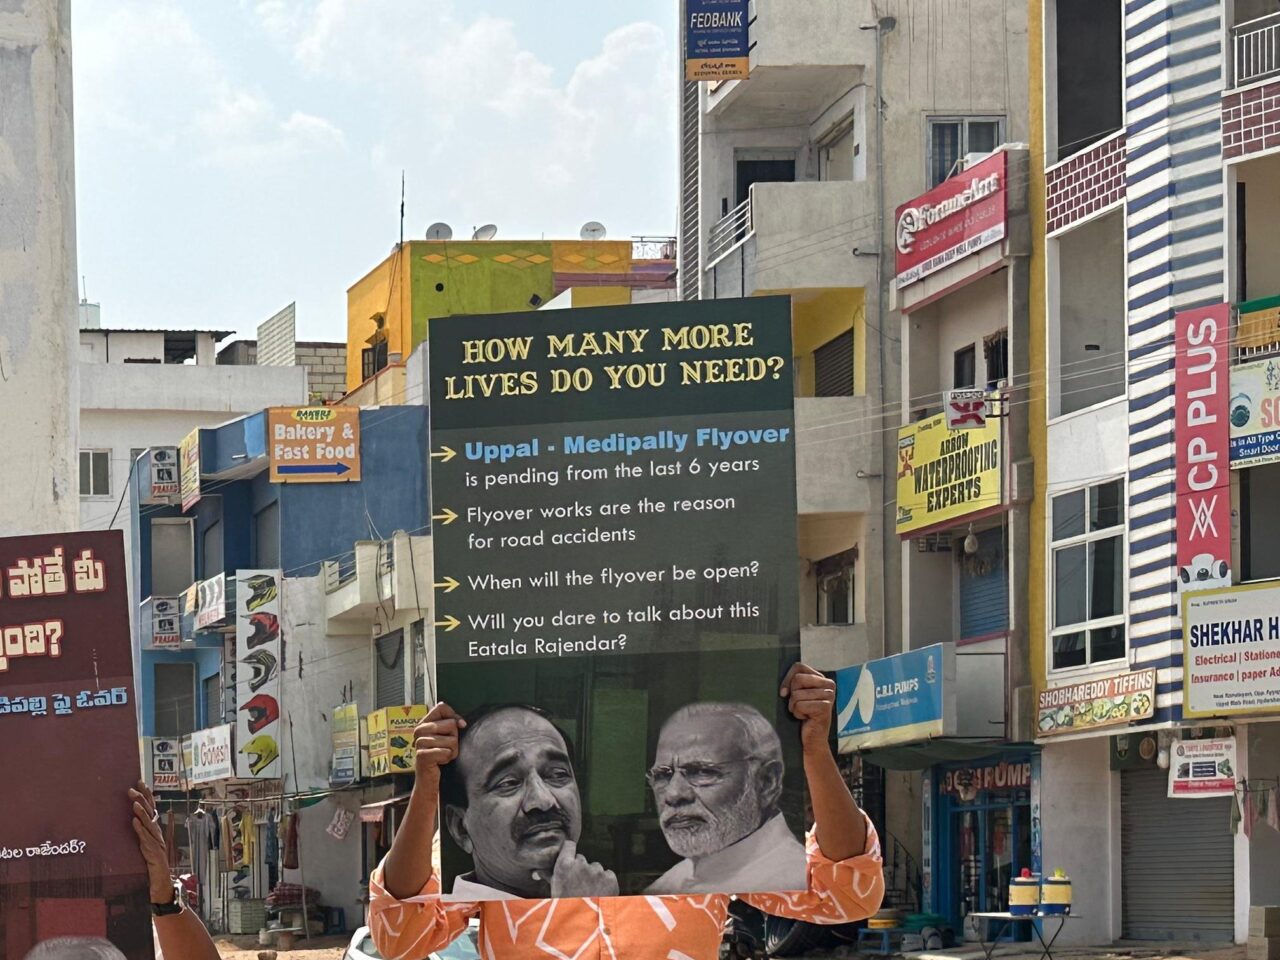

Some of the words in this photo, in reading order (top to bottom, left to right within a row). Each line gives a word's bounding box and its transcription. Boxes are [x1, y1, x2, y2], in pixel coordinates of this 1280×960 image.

[462, 336, 533, 363] HOW
[547, 329, 649, 357] MANY
[661, 323, 754, 350] MORE
[445, 371, 538, 399] LIVES
[551, 368, 592, 392] DO
[604, 363, 666, 389] YOU
[680, 356, 784, 385] NEED?
[1186, 317, 1218, 427] PLUS
[275, 424, 335, 442] Bakery
[342, 423, 354, 439] &
[466, 439, 538, 463] Uppal
[565, 431, 688, 455] Medipally
[697, 428, 789, 450] Flyover
[274, 444, 310, 460] Fast
[316, 443, 356, 460] Food
[914, 439, 997, 495] WATERPROOFING
[1187, 436, 1218, 491] CP
[466, 472, 477, 487] is
[485, 468, 558, 489] pending
[567, 465, 608, 481] from
[615, 463, 643, 478] the
[651, 461, 681, 476] last
[689, 458, 700, 474] 6
[708, 460, 759, 478] years
[926, 476, 981, 513] EXPERTS
[468, 507, 533, 526] Flyover
[540, 501, 592, 517] works
[600, 504, 631, 516] are
[638, 498, 665, 513] the
[674, 498, 735, 512] reason
[469, 533, 493, 549] for
[501, 530, 544, 547] road
[552, 527, 636, 545] accidents
[8, 547, 66, 597] పోతే
[73, 550, 105, 591] మీ
[468, 574, 521, 590] When
[529, 571, 558, 587] will
[566, 570, 593, 585] the
[601, 568, 665, 587] flyover
[673, 565, 697, 580] be
[704, 561, 759, 582] open?
[468, 613, 504, 629] Will
[513, 616, 544, 633] you
[552, 610, 596, 627] dare
[603, 610, 620, 623] to
[627, 606, 661, 622] talk
[670, 604, 723, 620] about
[730, 602, 759, 618] this
[1190, 618, 1264, 648] SHEKHAR
[469, 639, 527, 657] Eatala
[535, 634, 627, 654] Rajendar?
[1195, 652, 1237, 666] Electrical
[894, 677, 919, 695] PUMPS
[1040, 679, 1111, 708] SHOBHAREDDY
[1113, 671, 1153, 694] TIFFINS
[1241, 669, 1268, 682] paper
